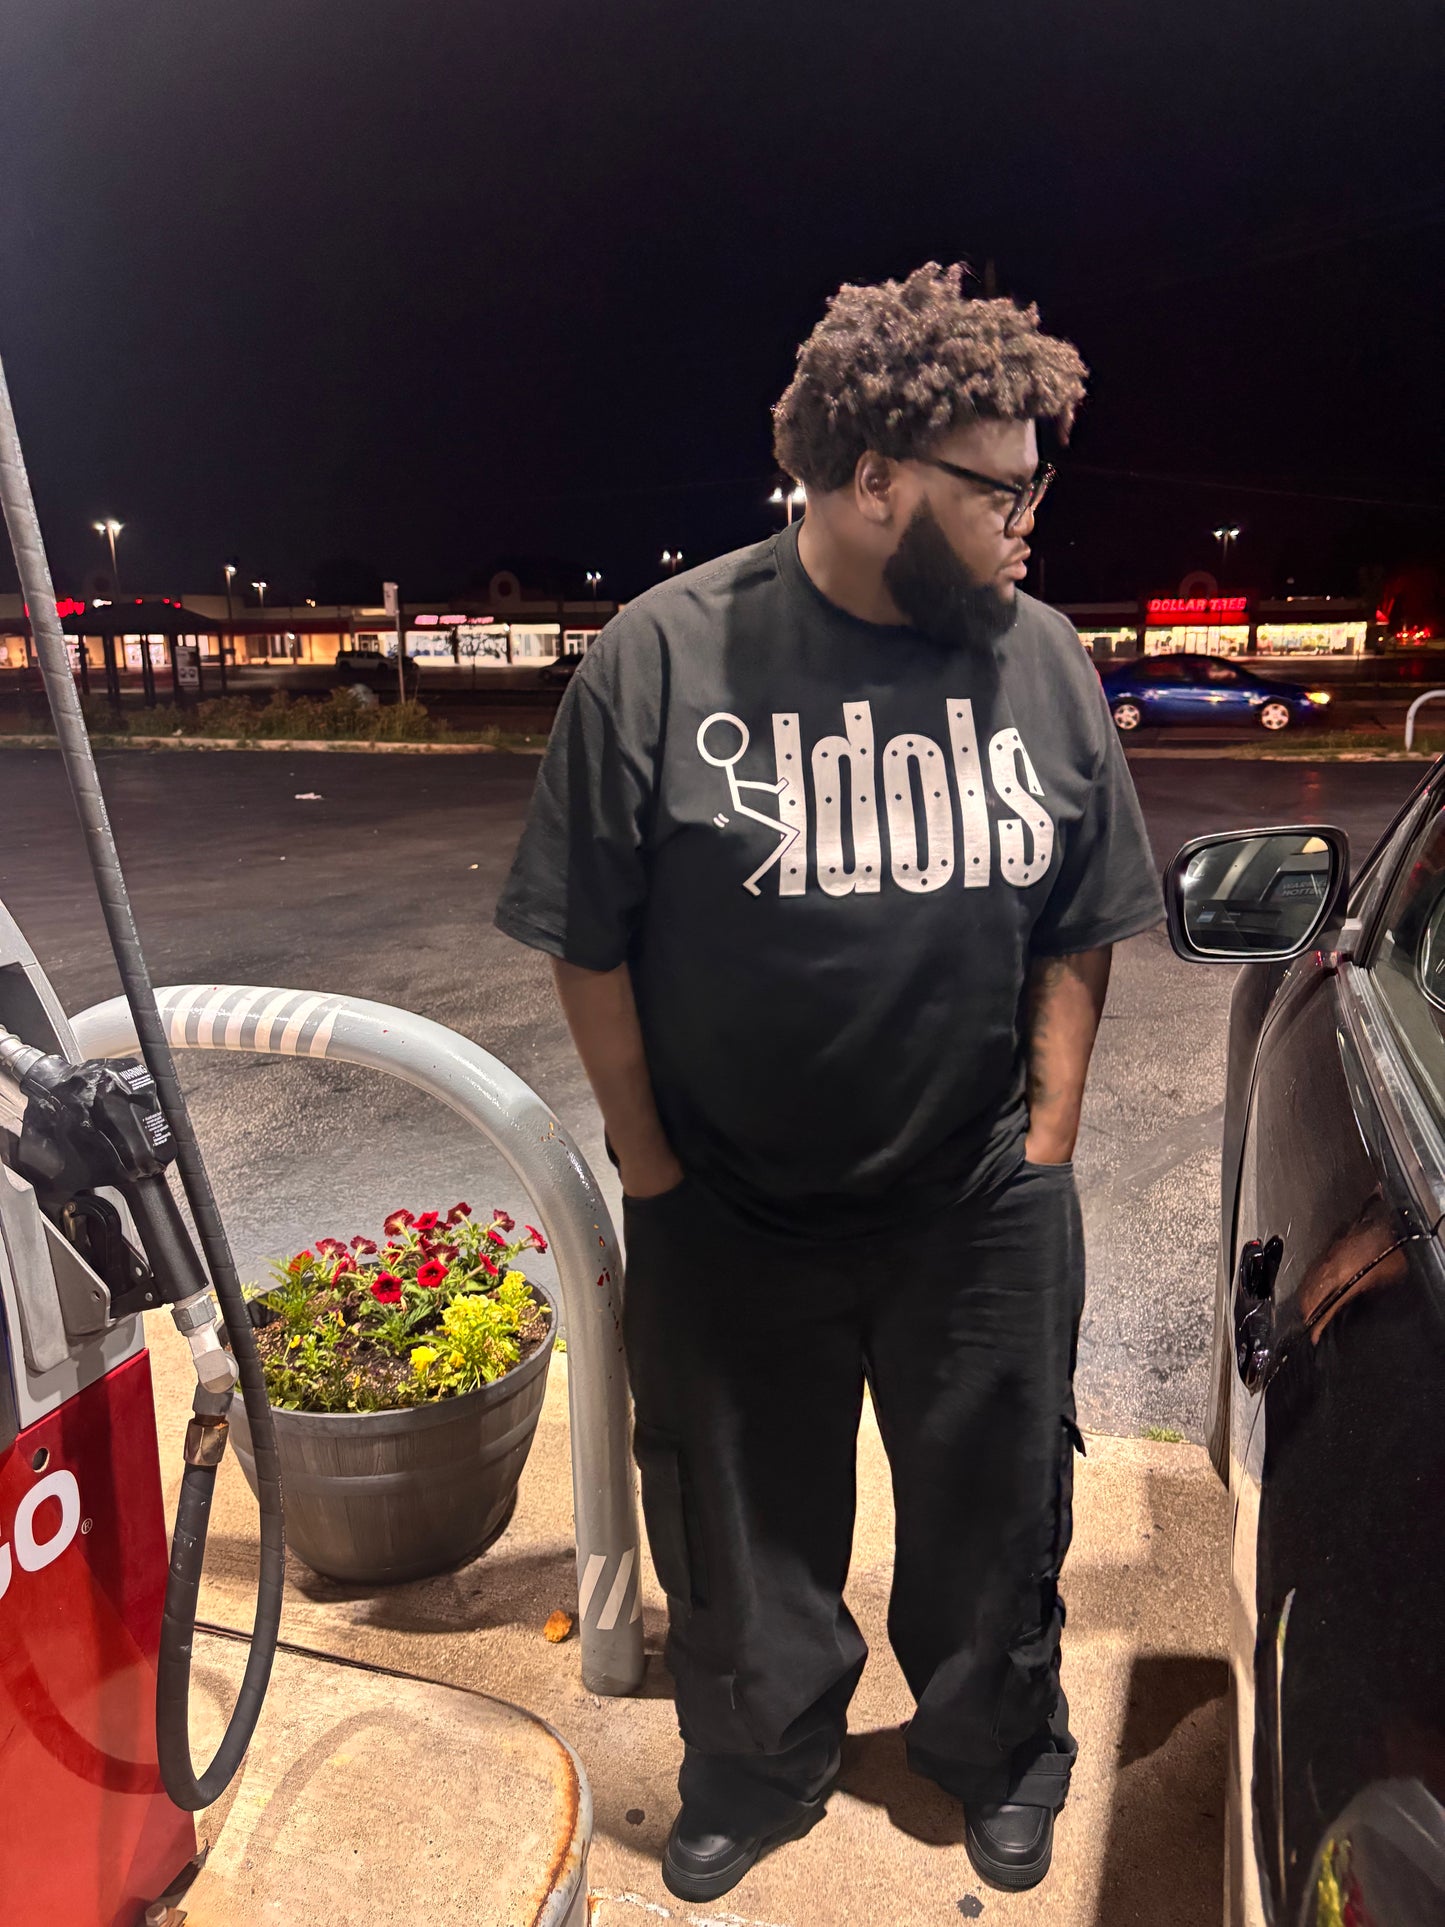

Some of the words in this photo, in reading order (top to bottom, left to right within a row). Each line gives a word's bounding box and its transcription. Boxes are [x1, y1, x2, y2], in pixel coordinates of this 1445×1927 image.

[1149, 598, 1206, 612] DOLLAR
[1208, 597, 1247, 611] TREE
[772, 698, 1054, 898] Idols
[119, 1064, 147, 1081] WARNING
